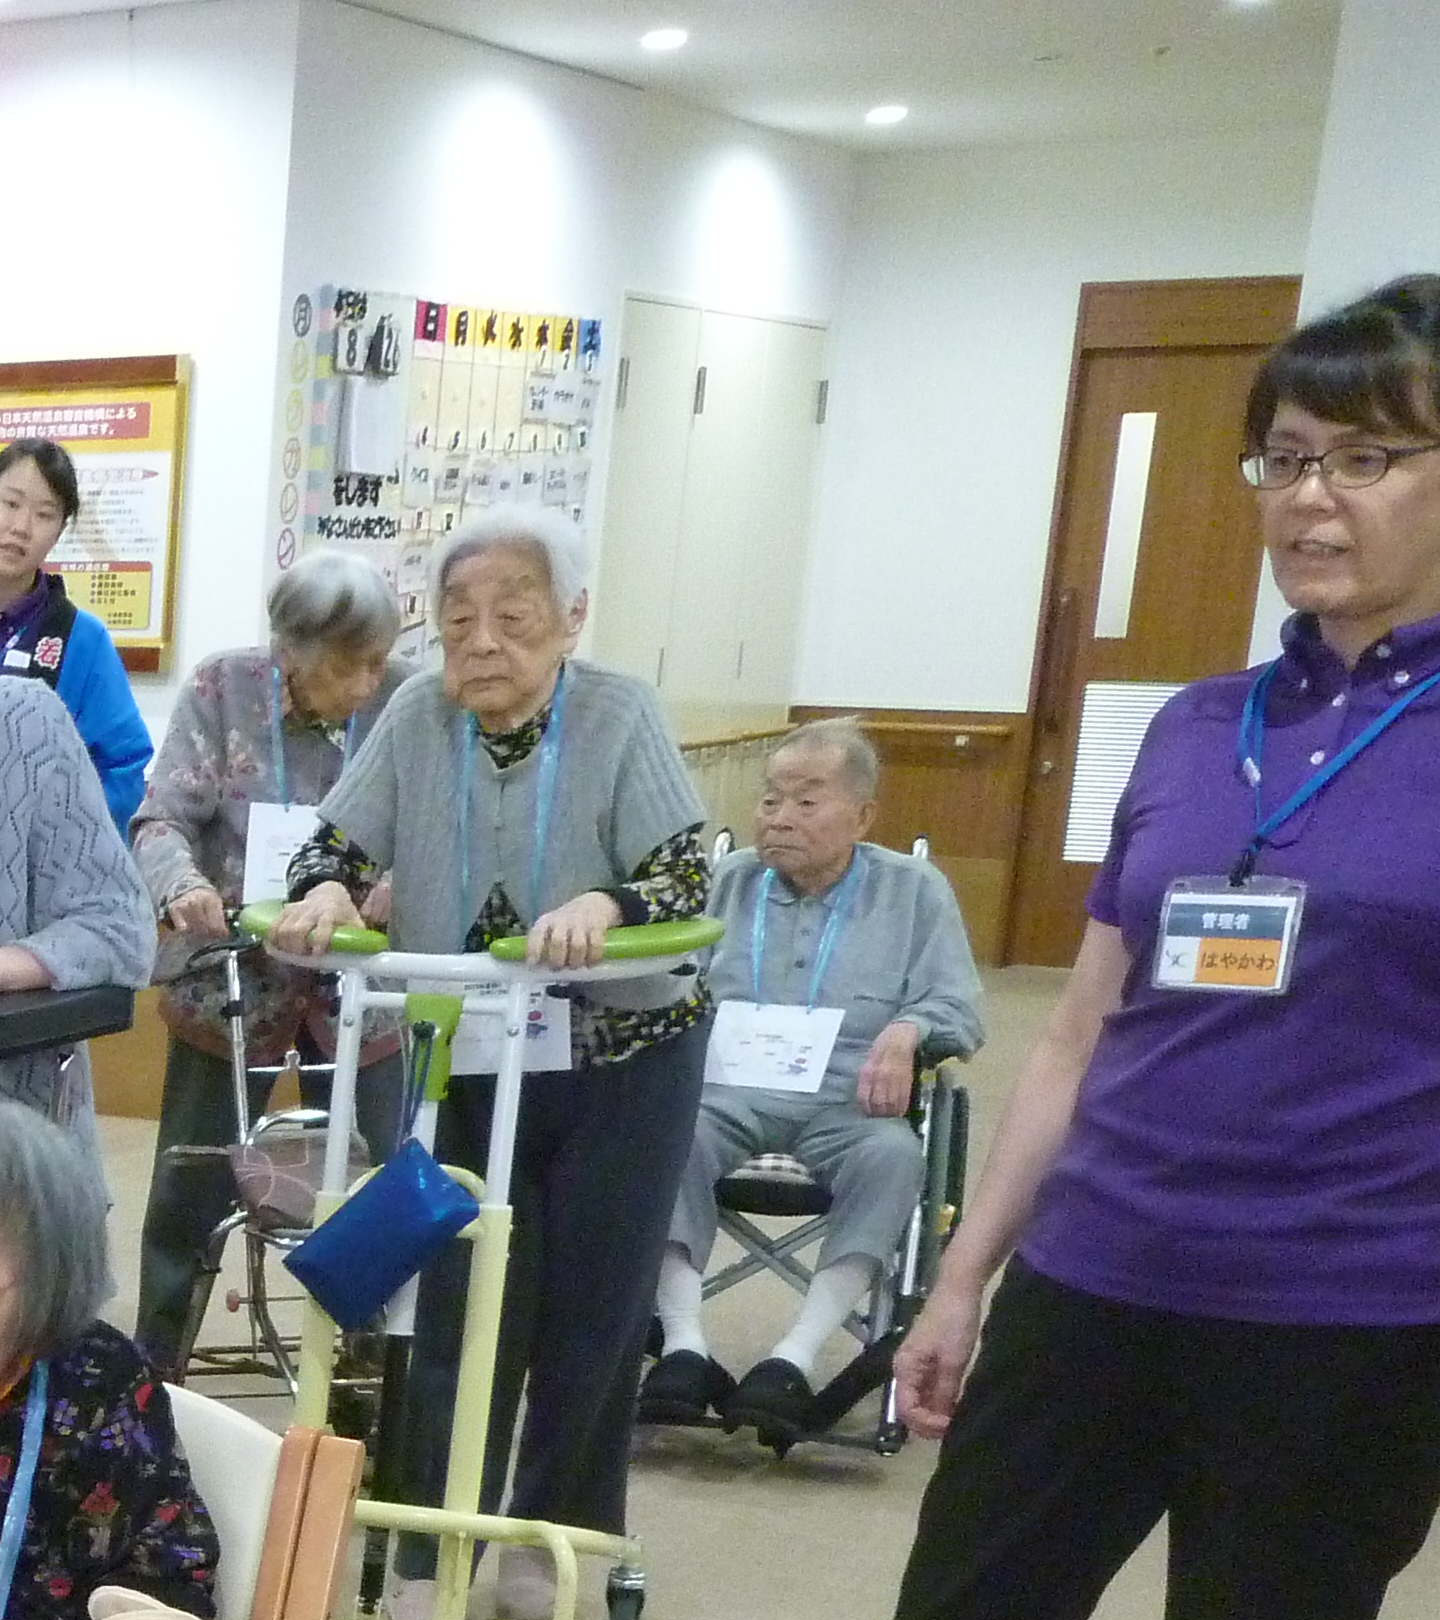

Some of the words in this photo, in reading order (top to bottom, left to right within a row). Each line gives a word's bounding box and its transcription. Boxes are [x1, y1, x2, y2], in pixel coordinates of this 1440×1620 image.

[422, 301, 439, 342] 日
[454, 310, 468, 346] 月
[1200, 952, 1277, 971] はやかわ
